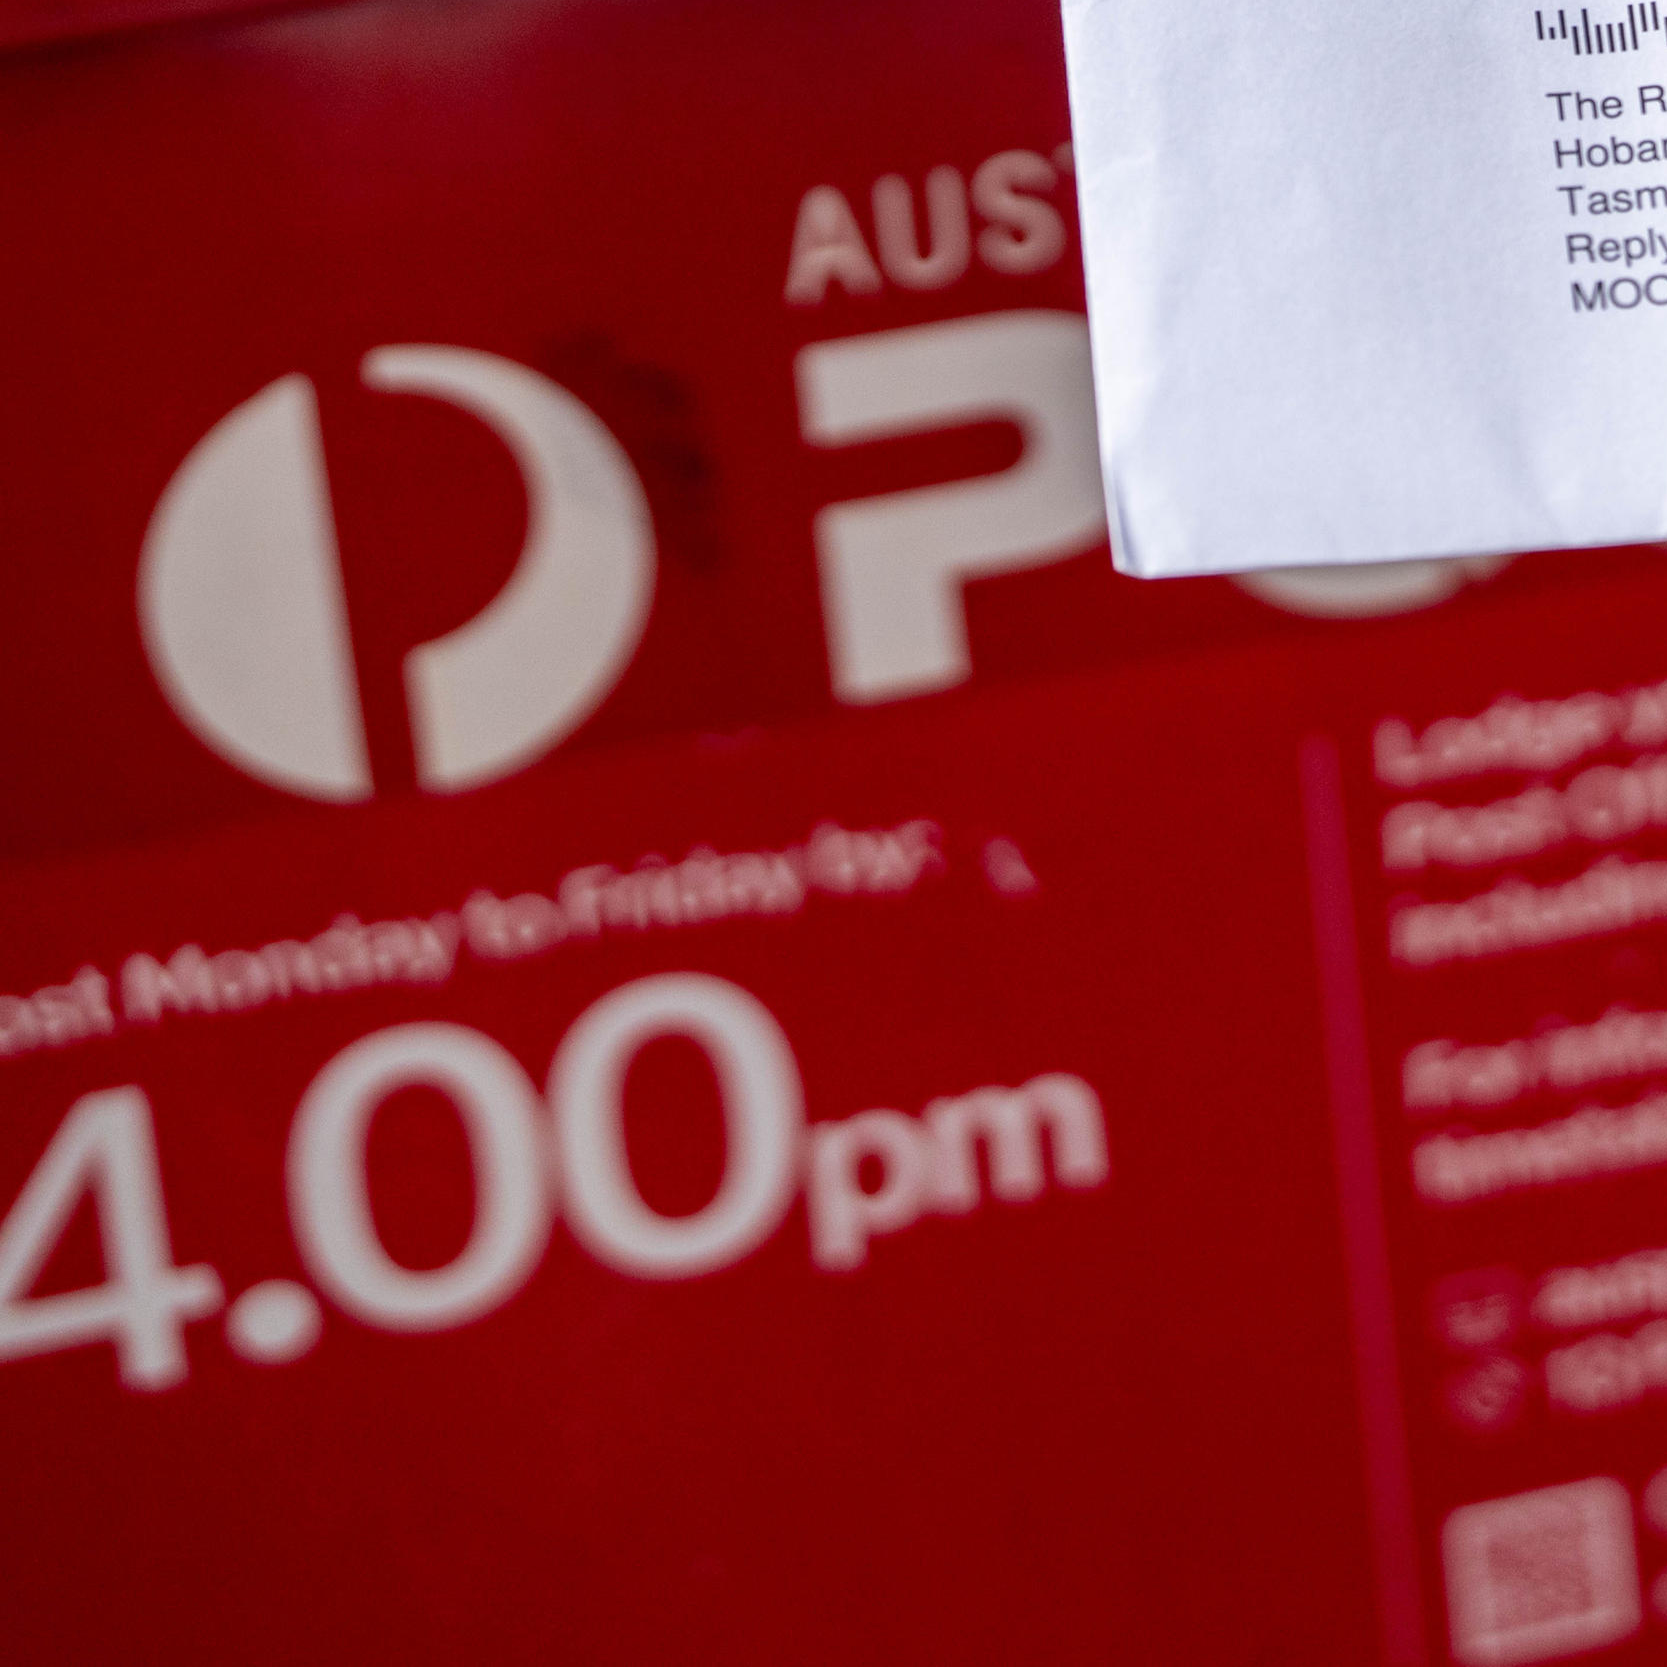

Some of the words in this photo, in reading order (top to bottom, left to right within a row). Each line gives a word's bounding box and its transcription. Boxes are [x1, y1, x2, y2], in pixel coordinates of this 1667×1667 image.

[1545, 91, 1623, 122] The
[783, 139, 1075, 306] AUS
[118, 912, 463, 1029] Monday
[460, 886, 565, 962] to
[558, 841, 805, 939] Friday
